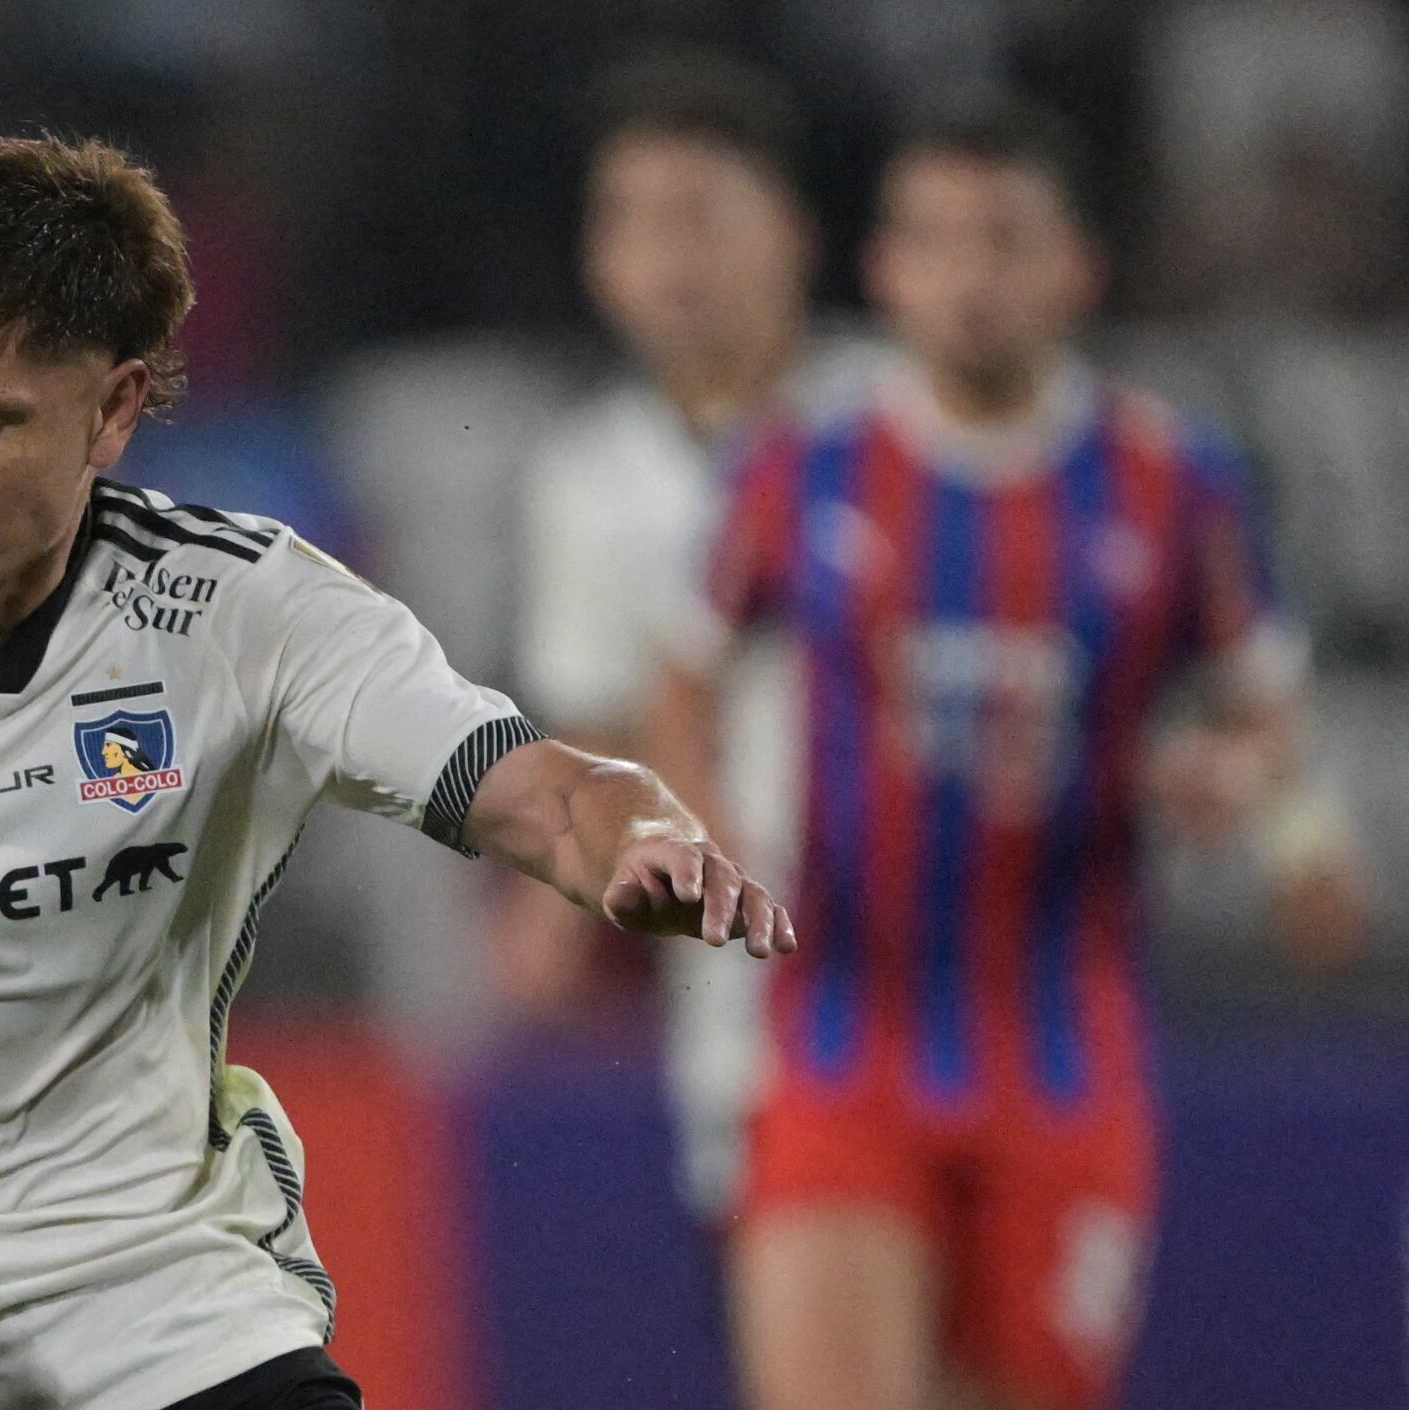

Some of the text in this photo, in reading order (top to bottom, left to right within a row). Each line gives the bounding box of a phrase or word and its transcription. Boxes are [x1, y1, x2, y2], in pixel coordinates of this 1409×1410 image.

[101, 558, 219, 603] Plsen
[124, 594, 203, 637] Sur
[83, 771, 180, 799] COLO-COLO
